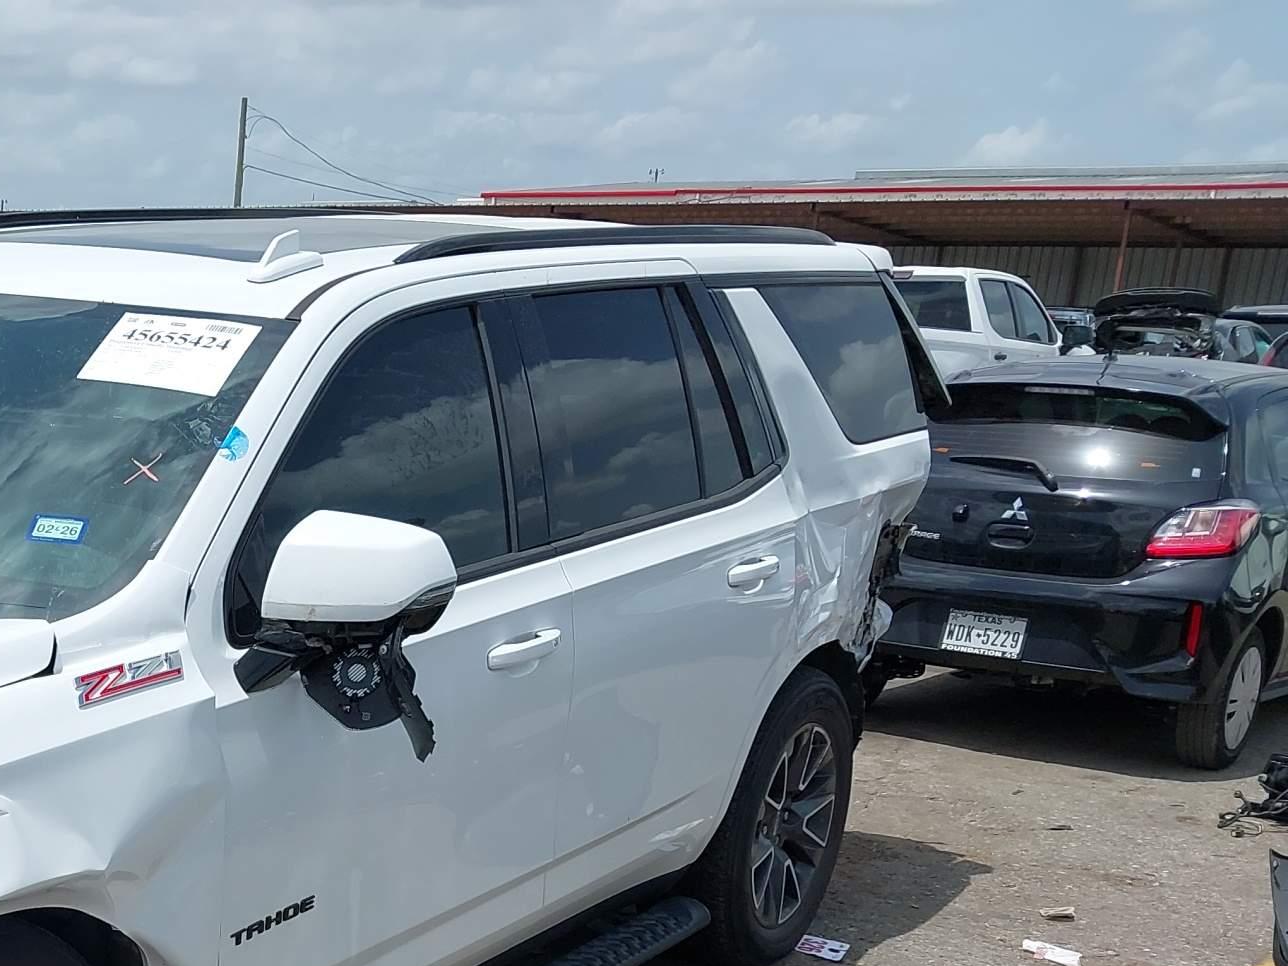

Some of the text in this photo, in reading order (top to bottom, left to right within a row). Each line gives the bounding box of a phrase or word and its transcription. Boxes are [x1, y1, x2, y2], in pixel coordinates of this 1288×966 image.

[122, 328, 232, 351] 45655424
[973, 614, 1003, 625] TEXAS
[941, 643, 1002, 657] FOUNDATION
[74, 649, 185, 710] Z71
[230, 894, 316, 947] TAHOE
